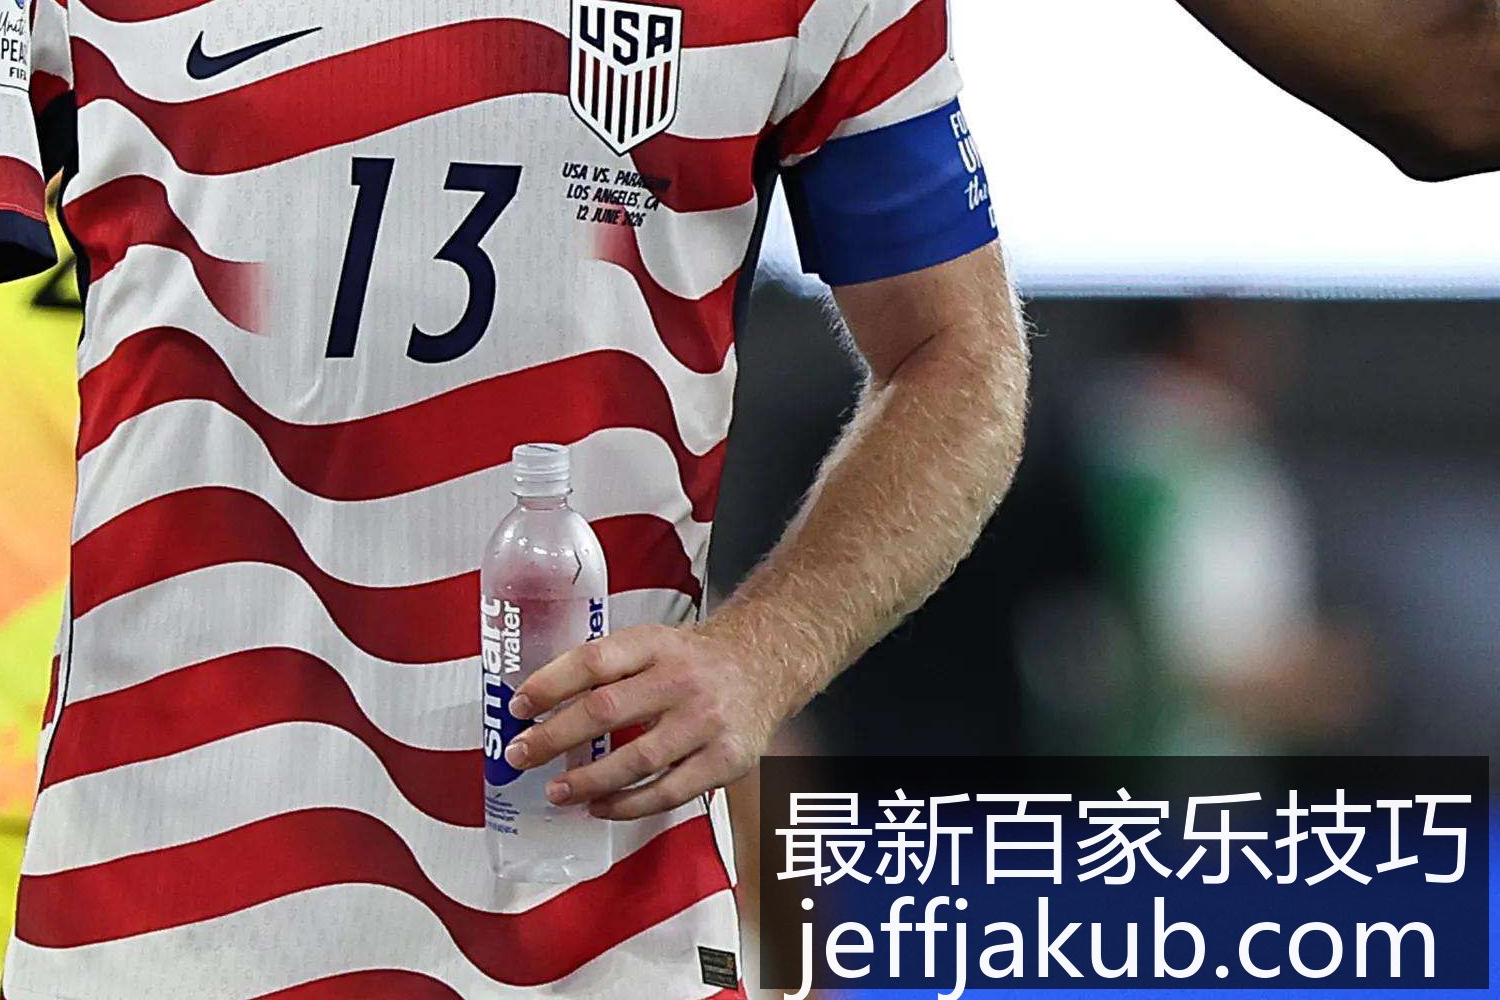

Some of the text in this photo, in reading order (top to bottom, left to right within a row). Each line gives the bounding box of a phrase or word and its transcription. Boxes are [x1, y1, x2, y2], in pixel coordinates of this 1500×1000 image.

[1, 37, 30, 67] PEA
[580, 6, 673, 66] USA
[562, 162, 588, 180] USA
[592, 167, 610, 182] VS.
[566, 184, 660, 212] LOS ANGELES, CA
[576, 205, 589, 221] 12
[591, 208, 621, 225] JUNE
[325, 157, 522, 363] 13
[502, 600, 521, 673] water
[586, 597, 604, 643] ter
